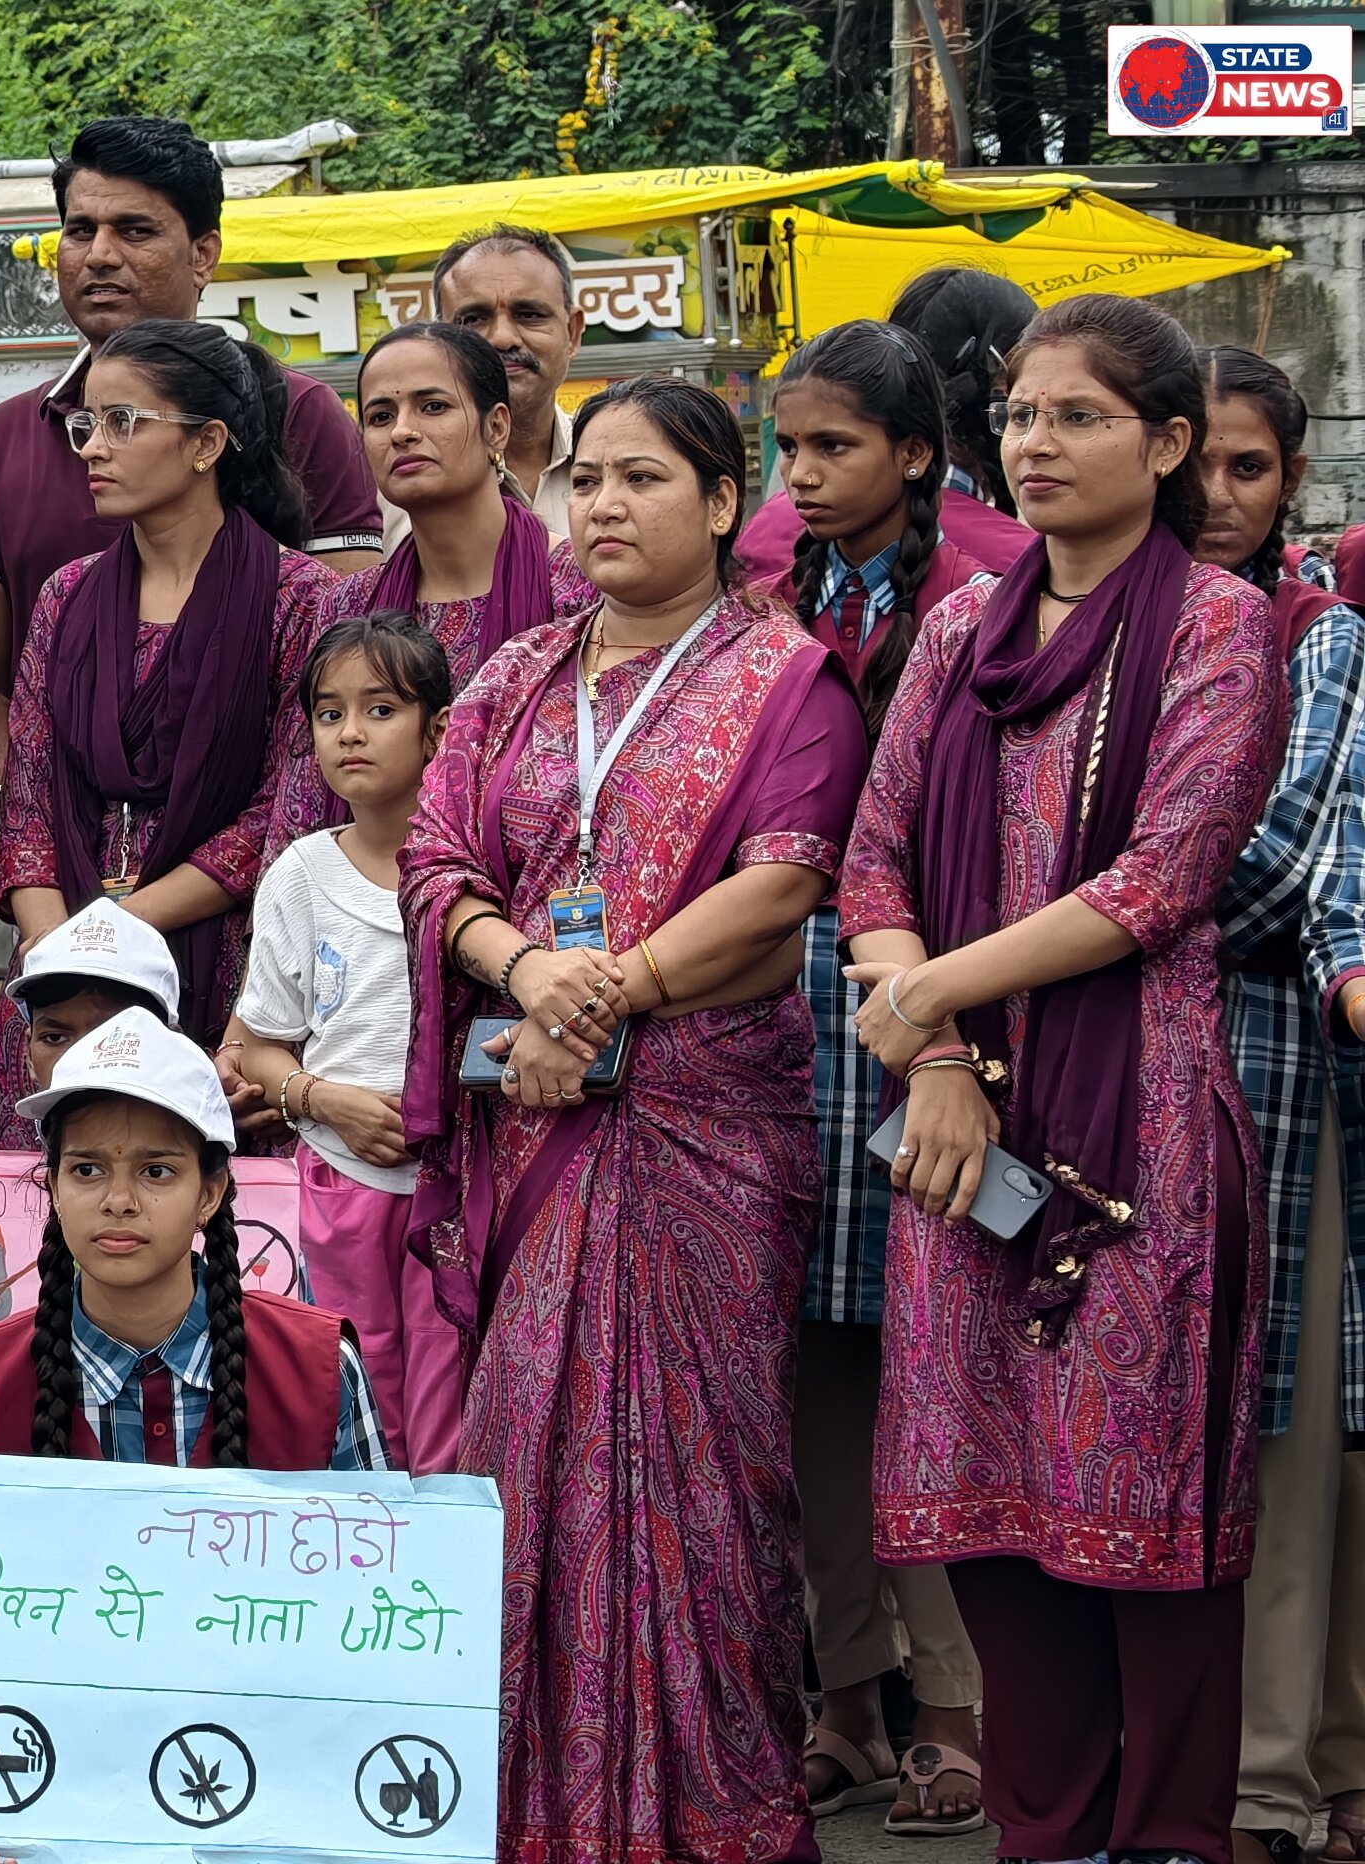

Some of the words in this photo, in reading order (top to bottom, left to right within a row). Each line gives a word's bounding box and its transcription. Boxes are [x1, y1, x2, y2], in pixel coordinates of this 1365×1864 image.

[137, 1508, 278, 1567] नशा
[289, 1491, 410, 1578] छोड़ो
[95, 1565, 163, 1641] से
[195, 1593, 318, 1646] नाता
